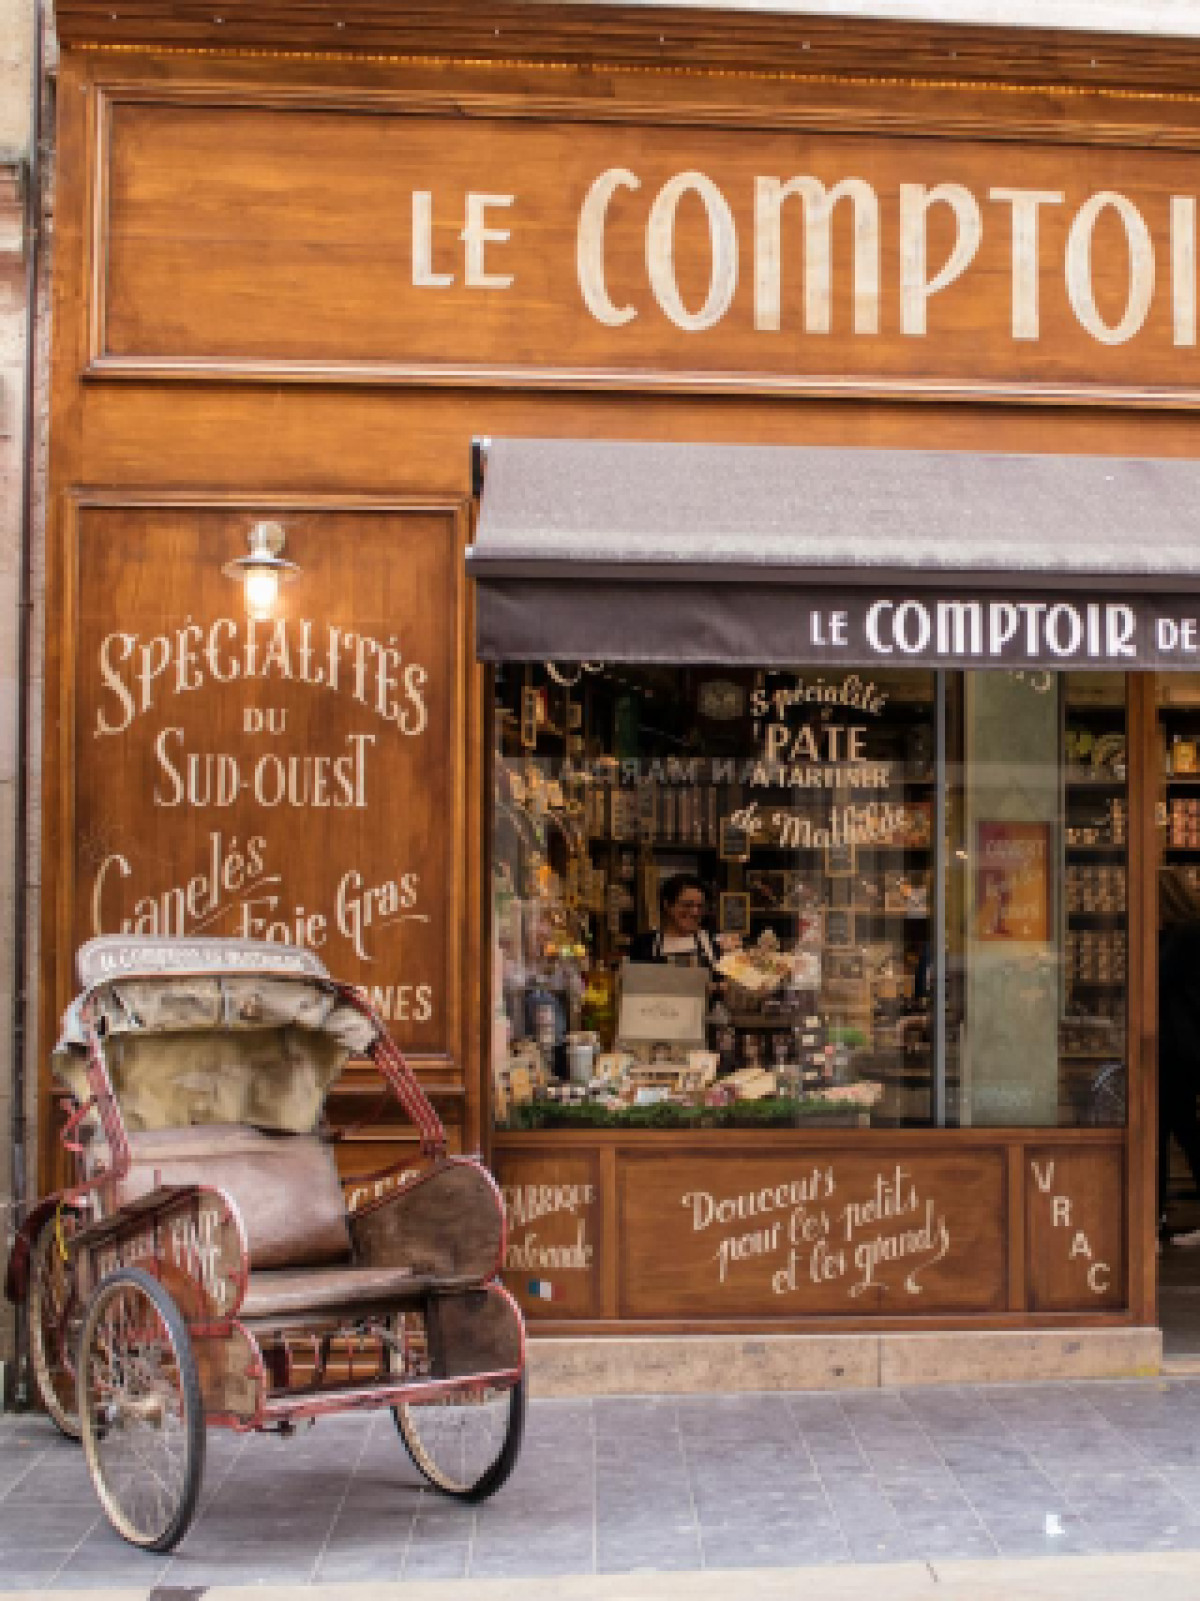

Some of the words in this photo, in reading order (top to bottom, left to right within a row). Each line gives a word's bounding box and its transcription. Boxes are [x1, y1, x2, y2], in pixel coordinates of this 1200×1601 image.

[411, 190, 515, 289] LE
[93, 613, 428, 737] SPÉCIALITÉS
[809, 610, 848, 646] LE
[865, 600, 1137, 657] COMPTOIR
[1155, 617, 1198, 653] DE
[153, 727, 376, 807] SUD-OUEST
[243, 708, 287, 735] DU
[731, 802, 763, 832] de
[93, 831, 270, 937] Canelés
[232, 896, 327, 946] Foie
[336, 870, 420, 961] Gras
[680, 1165, 835, 1231] Douceurs
[711, 1221, 784, 1283] pour
[787, 1206, 830, 1245] les
[838, 1164, 919, 1242] petits
[1031, 1161, 1112, 1294] VRAC
[772, 1247, 803, 1294] et
[810, 1240, 848, 1283] les
[848, 1198, 950, 1298] grands
